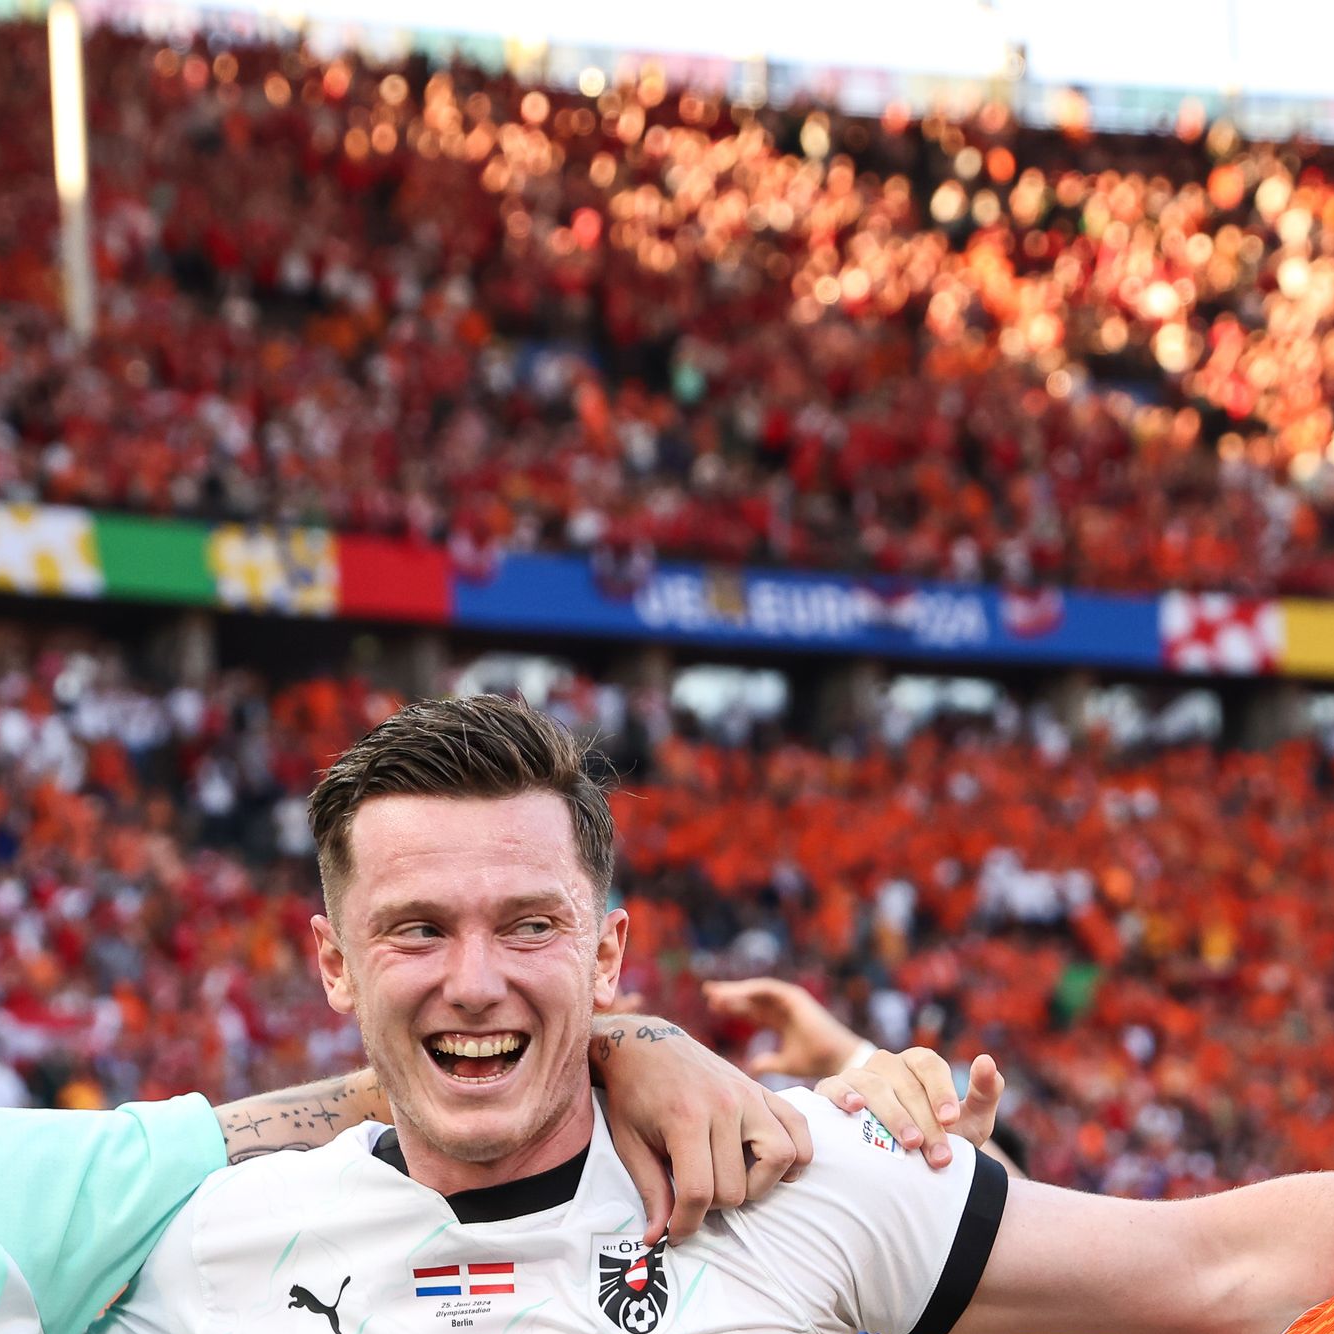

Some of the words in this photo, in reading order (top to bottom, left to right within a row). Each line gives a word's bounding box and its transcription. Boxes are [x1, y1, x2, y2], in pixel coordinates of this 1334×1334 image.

[618, 1239, 644, 1253] ÖF
[435, 1307, 491, 1318] Olympiastadion
[451, 1318, 474, 1327] Berlin
